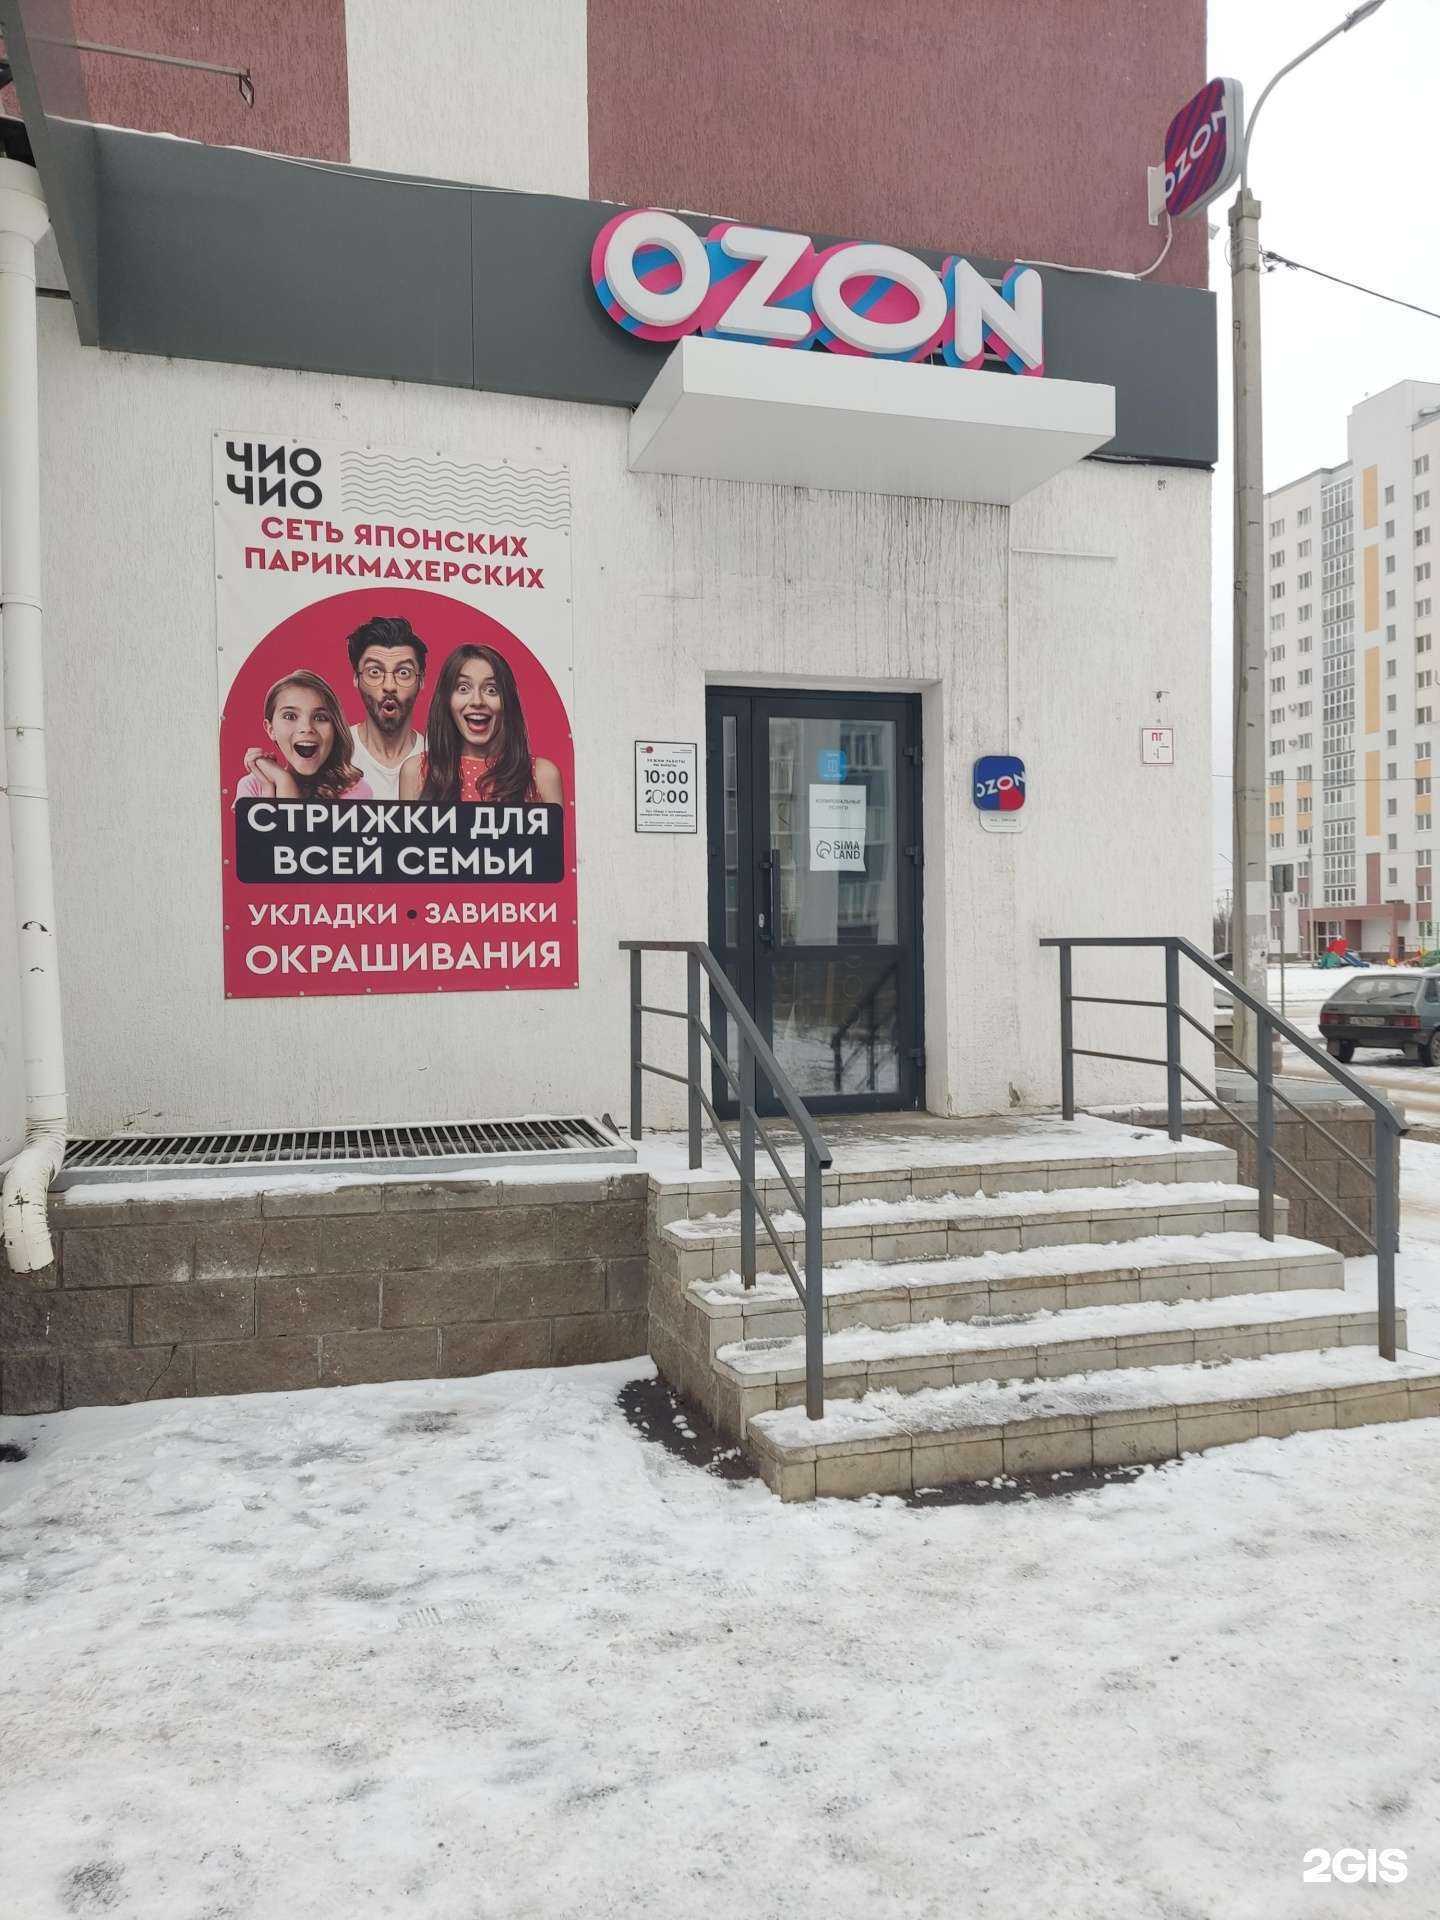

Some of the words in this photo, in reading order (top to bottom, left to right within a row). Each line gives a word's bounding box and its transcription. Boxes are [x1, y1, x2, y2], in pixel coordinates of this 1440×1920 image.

[602, 209, 1043, 373] OZON
[226, 441, 322, 477] ЧИО
[226, 474, 323, 510] ЧИО
[261, 516, 344, 543] СЕТЬ
[354, 523, 528, 558] ЯПОНСКИХ
[244, 546, 545, 589] ПАРИКМАХЕРСКИХ
[1152, 732, 1163, 742] ПГ
[644, 769, 688, 785] 10:00
[645, 789, 688, 804] 20:00
[247, 803, 457, 834] СТРИЖКИ
[470, 807, 549, 840] ДЛЯ
[273, 836, 383, 876] ВСЕЙ
[397, 847, 533, 875] СЕМЬИ
[833, 840, 860, 850] SIMA
[833, 850, 861, 860] LAND
[248, 904, 397, 929] УКЛАДКИ
[424, 902, 557, 925] ЗАВИВКИ
[245, 940, 561, 975] ОКРАШИВАНИЯ
